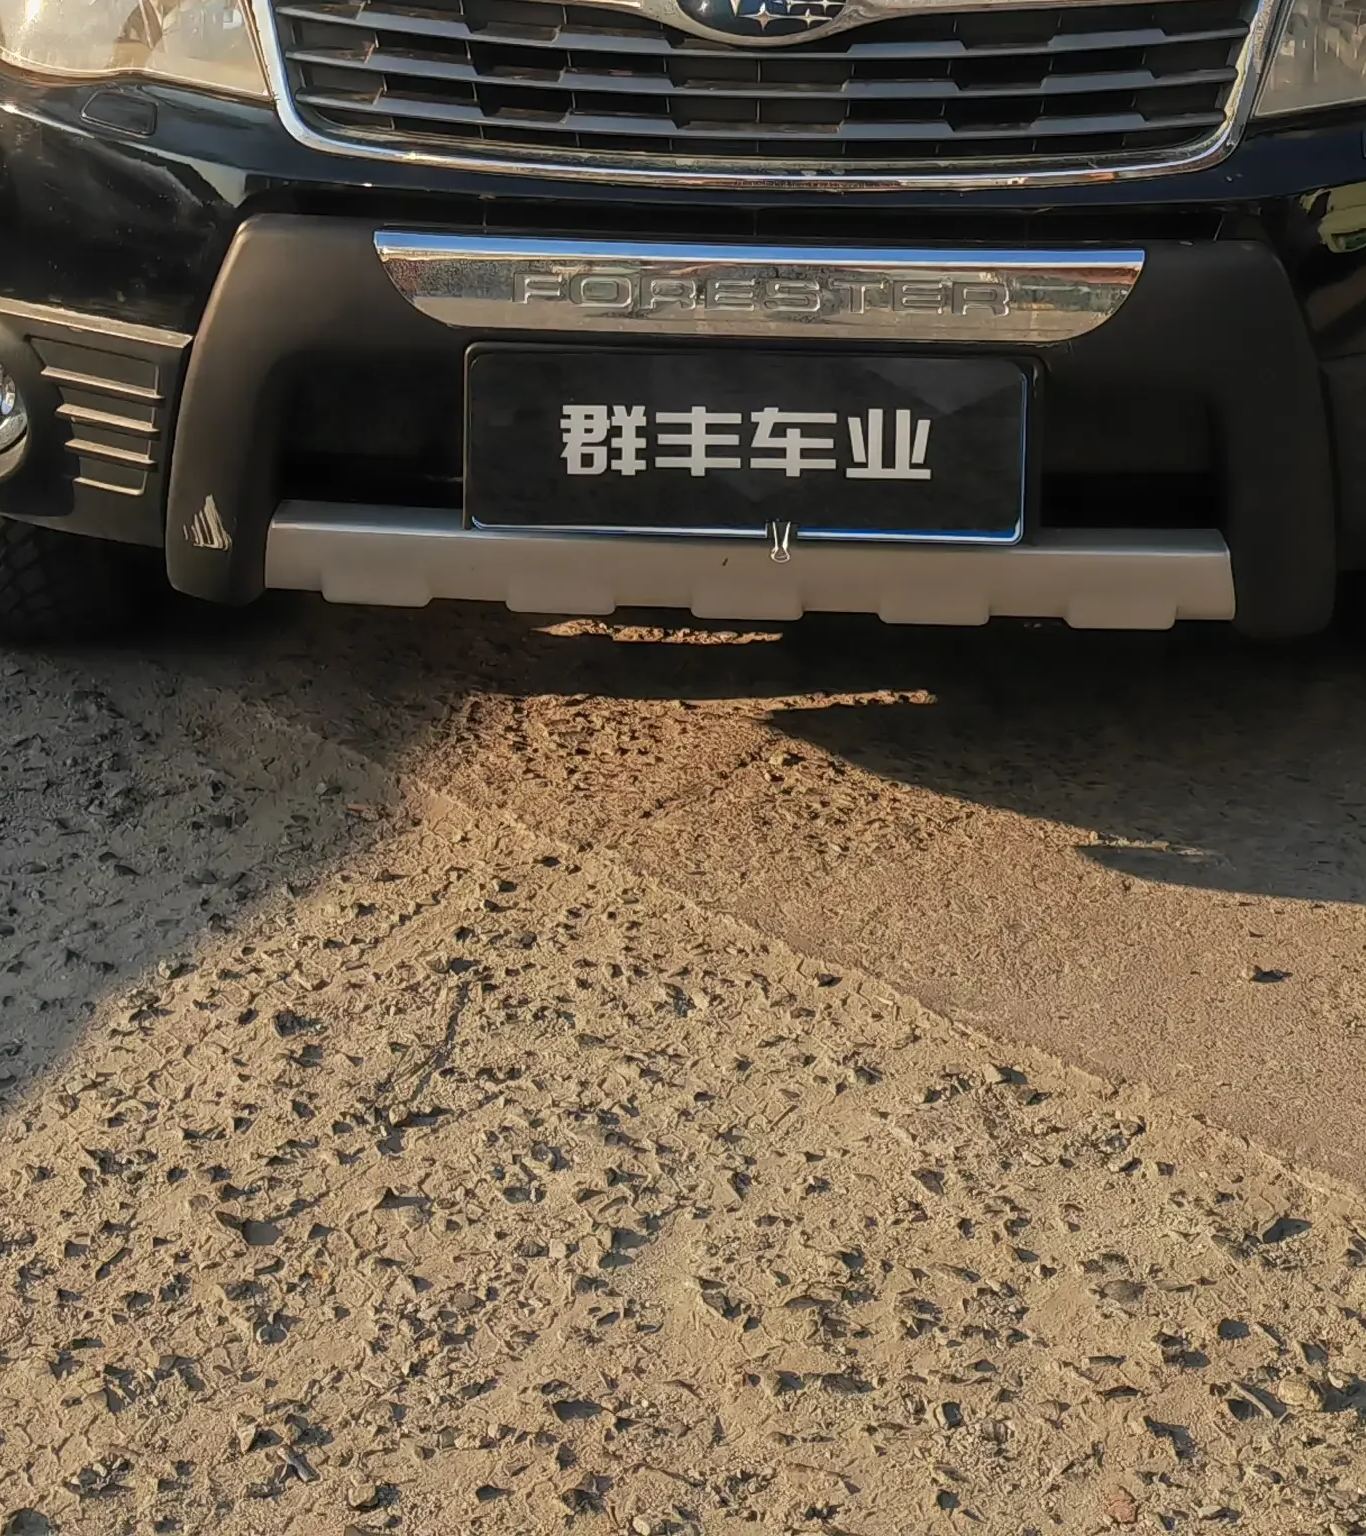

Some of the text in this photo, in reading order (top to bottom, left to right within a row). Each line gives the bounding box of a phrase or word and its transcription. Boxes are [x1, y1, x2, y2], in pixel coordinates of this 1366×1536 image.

[512, 271, 1012, 317] FORESTER
[559, 404, 933, 481] 群丰车业
